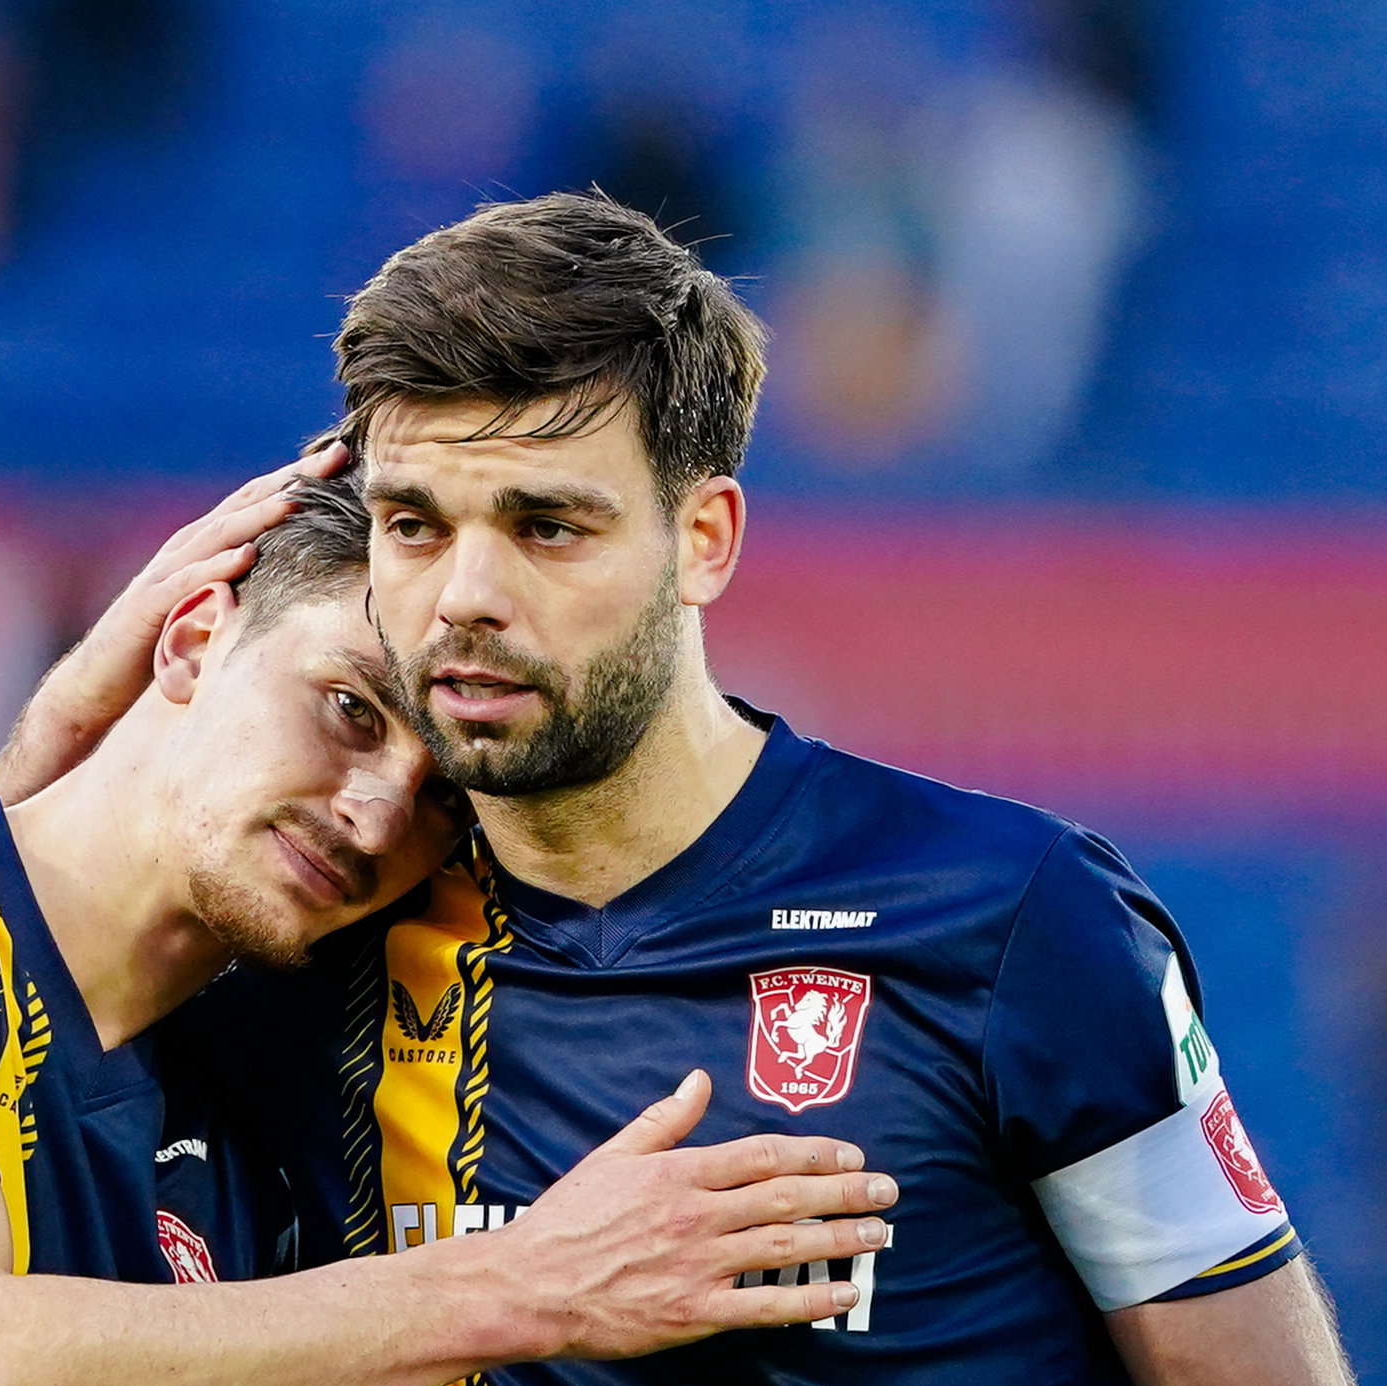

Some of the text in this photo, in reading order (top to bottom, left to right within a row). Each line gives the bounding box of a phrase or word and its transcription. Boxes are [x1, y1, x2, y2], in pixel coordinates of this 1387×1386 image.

[771, 909, 877, 930] ELEKTRAMAT
[758, 973, 863, 994] F.C. TWENTE
[388, 1047, 456, 1064] CASTORE
[780, 1082, 818, 1095] 1965
